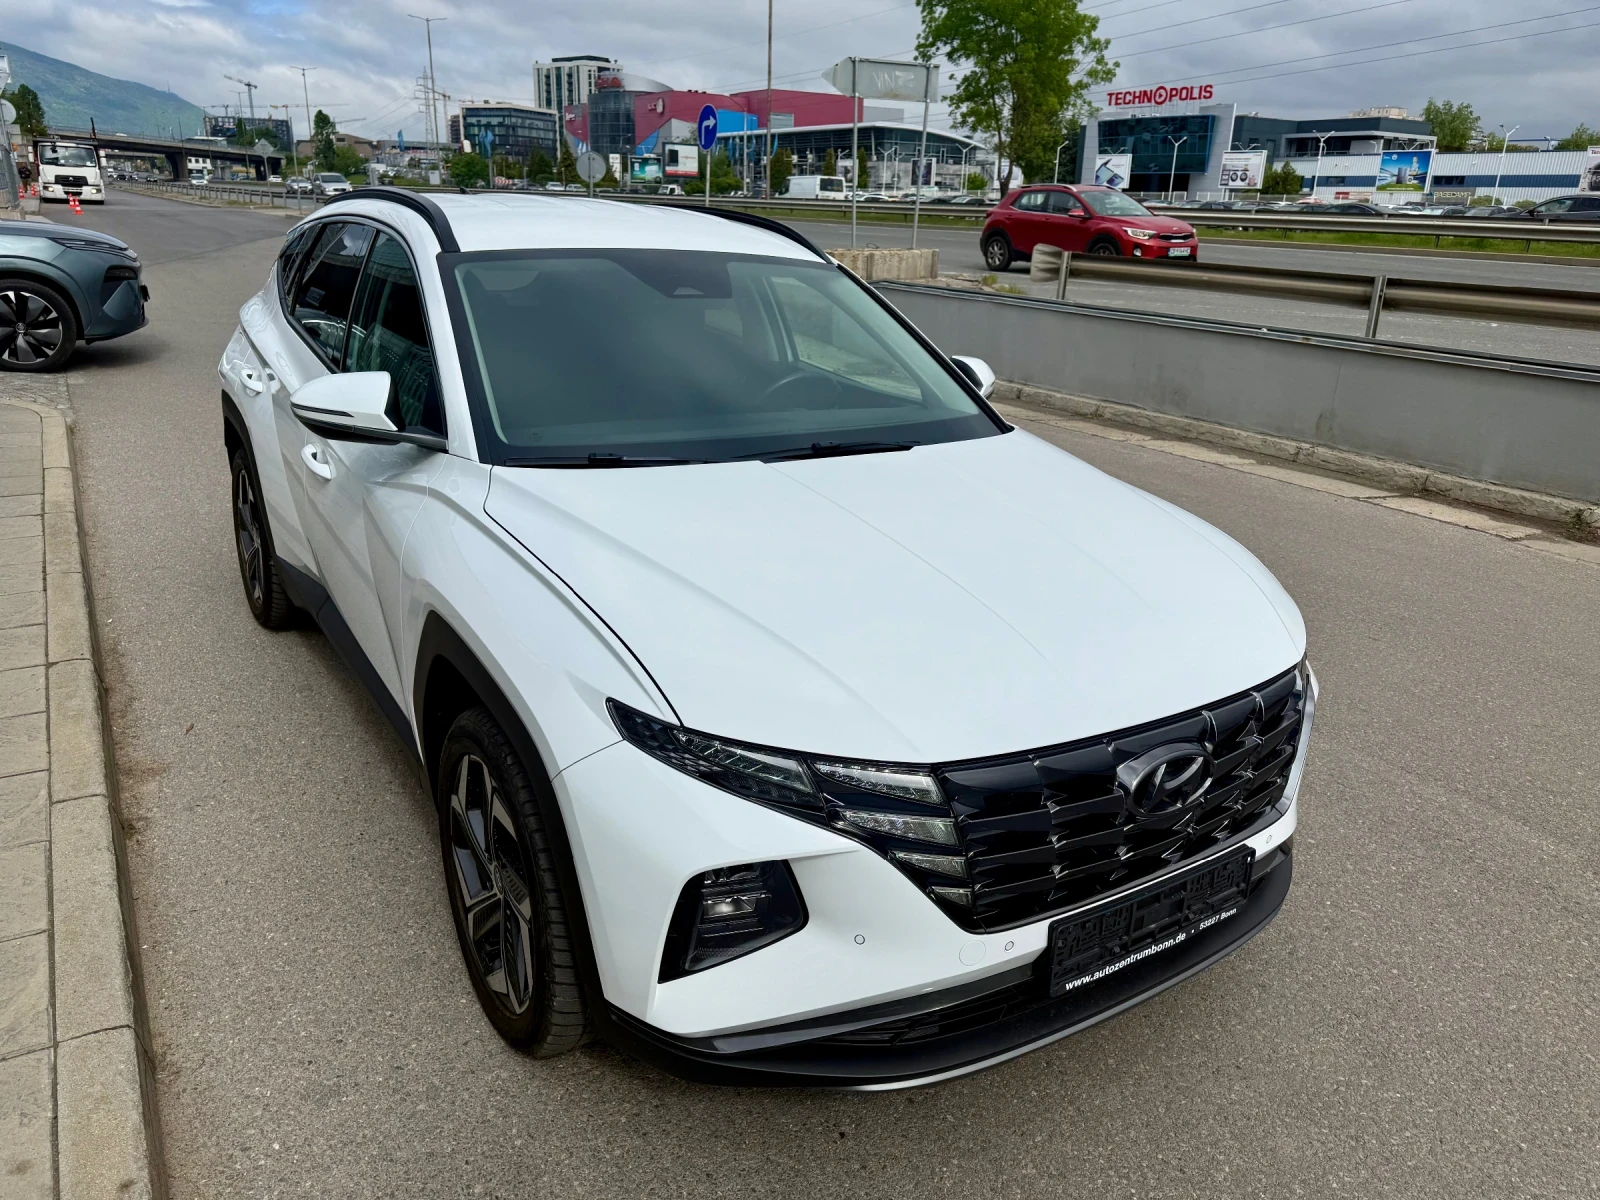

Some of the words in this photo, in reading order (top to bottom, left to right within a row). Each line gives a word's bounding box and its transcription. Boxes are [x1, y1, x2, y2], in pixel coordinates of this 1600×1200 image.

[1107, 84, 1213, 106] TECHNOPOLIS
[1065, 932, 1187, 991] www.autozentrumbonn.de
[1199, 914, 1220, 930] 53227
[1220, 908, 1237, 920] Bonn
